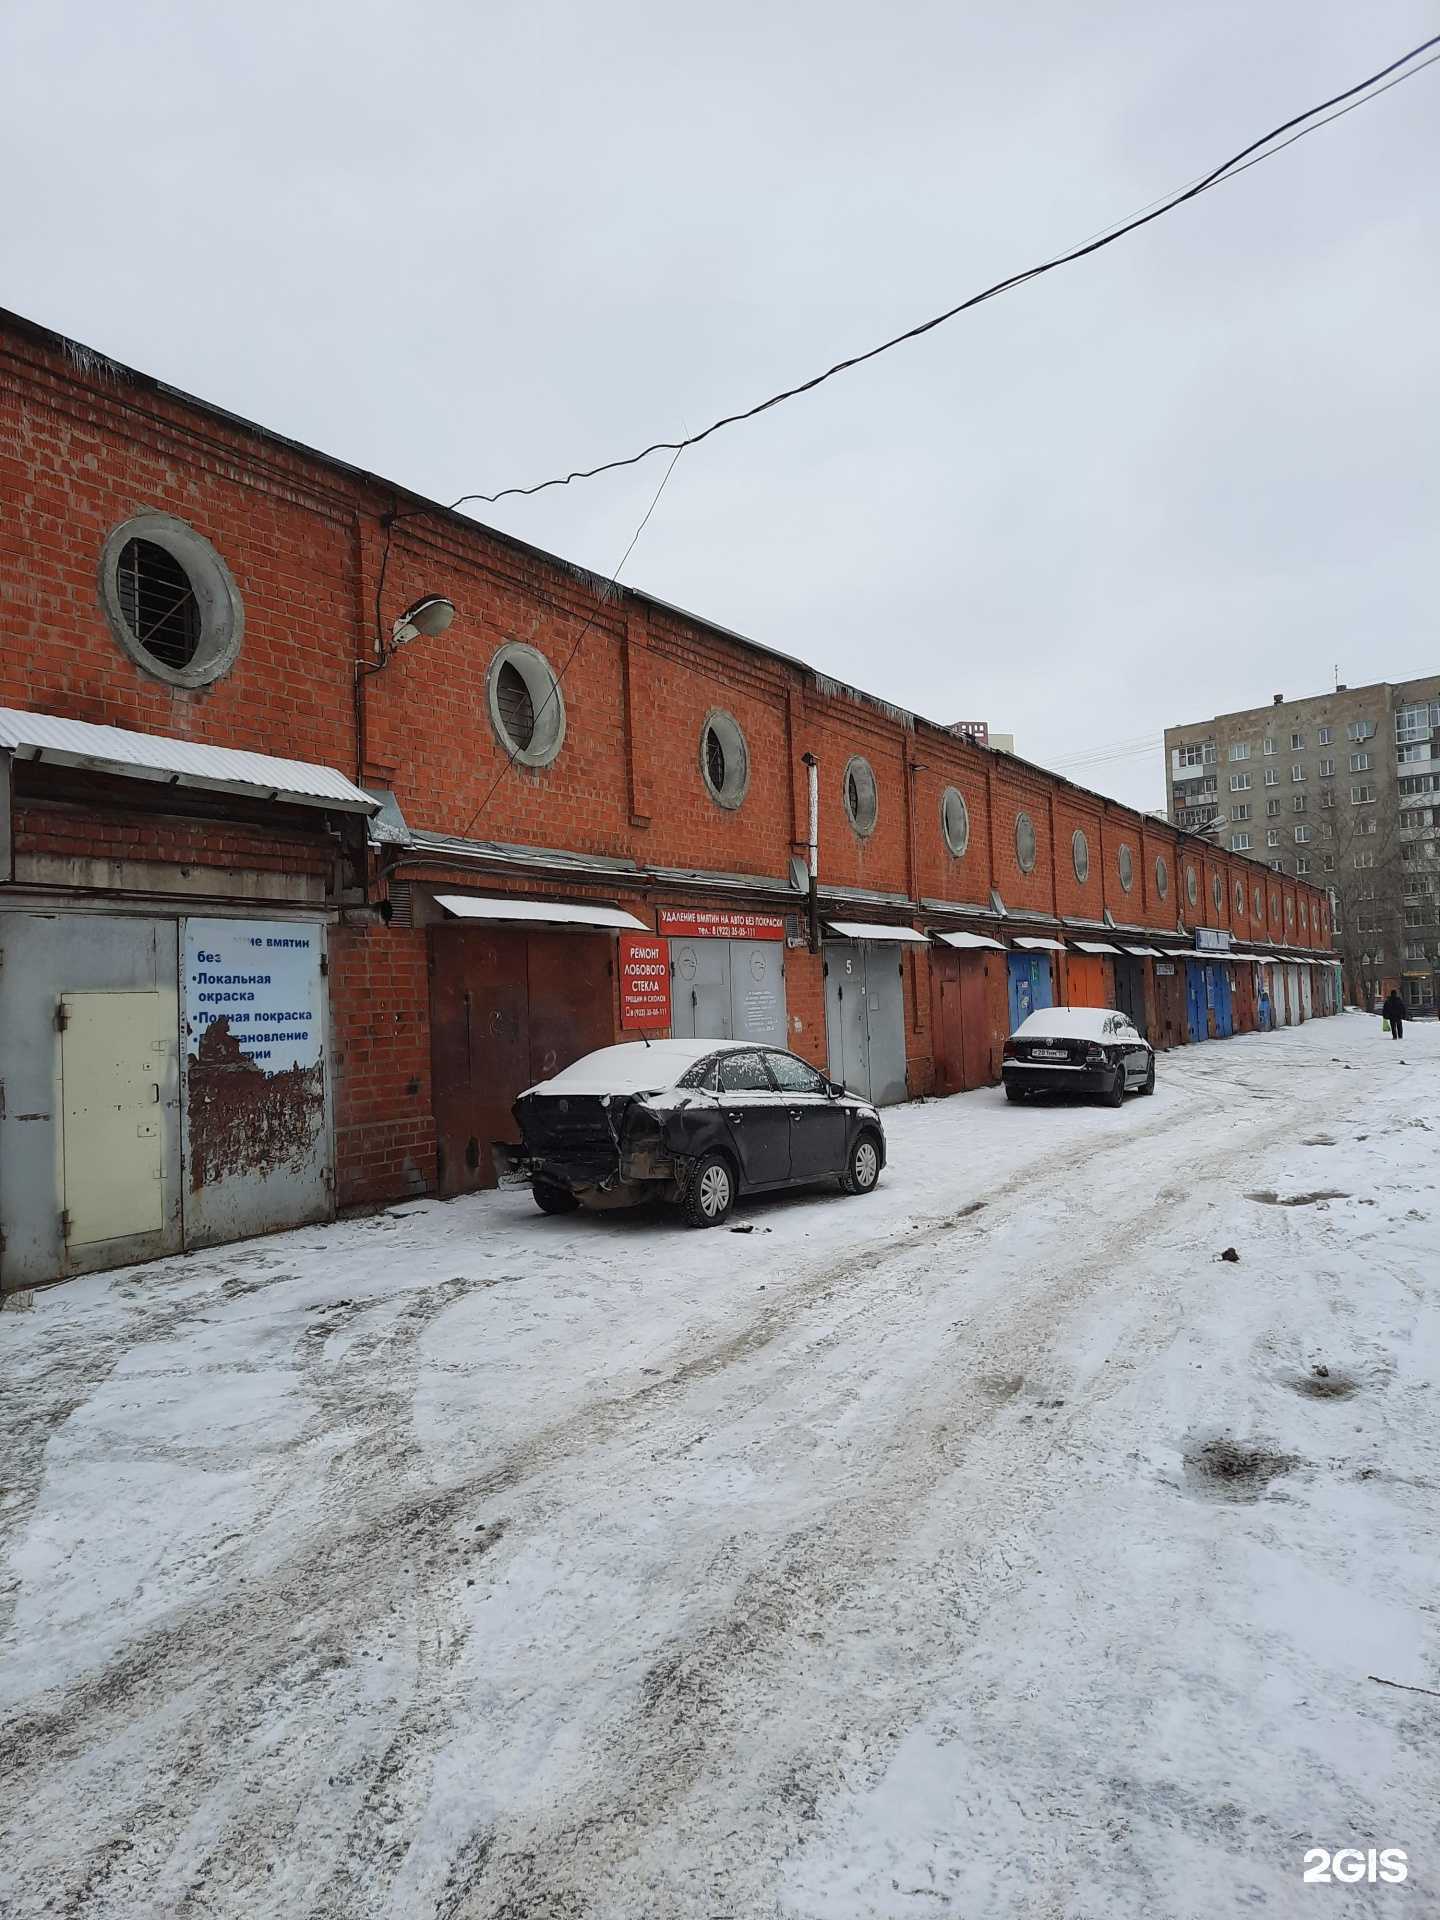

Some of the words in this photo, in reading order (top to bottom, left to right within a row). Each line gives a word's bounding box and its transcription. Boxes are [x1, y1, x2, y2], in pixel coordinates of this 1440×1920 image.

[662, 911, 696, 923] УДАЛЕНИЕ
[697, 913, 720, 924] ВМЯТИН
[720, 915, 730, 925] НА
[730, 915, 745, 925] АВТО
[745, 916, 755, 926] БЕЗ
[755, 917, 783, 928] ПОКРАСКИ
[266, 937, 310, 948] вмятин
[630, 948, 659, 959] РЕМОНТ
[624, 964, 665, 976] ЛОБОВОГО
[846, 959, 852, 974] 5
[197, 973, 271, 985] Локальная
[631, 980, 659, 992] СТЕКЛА
[198, 991, 255, 1004] окраска
[254, 1010, 312, 1023] покраска
